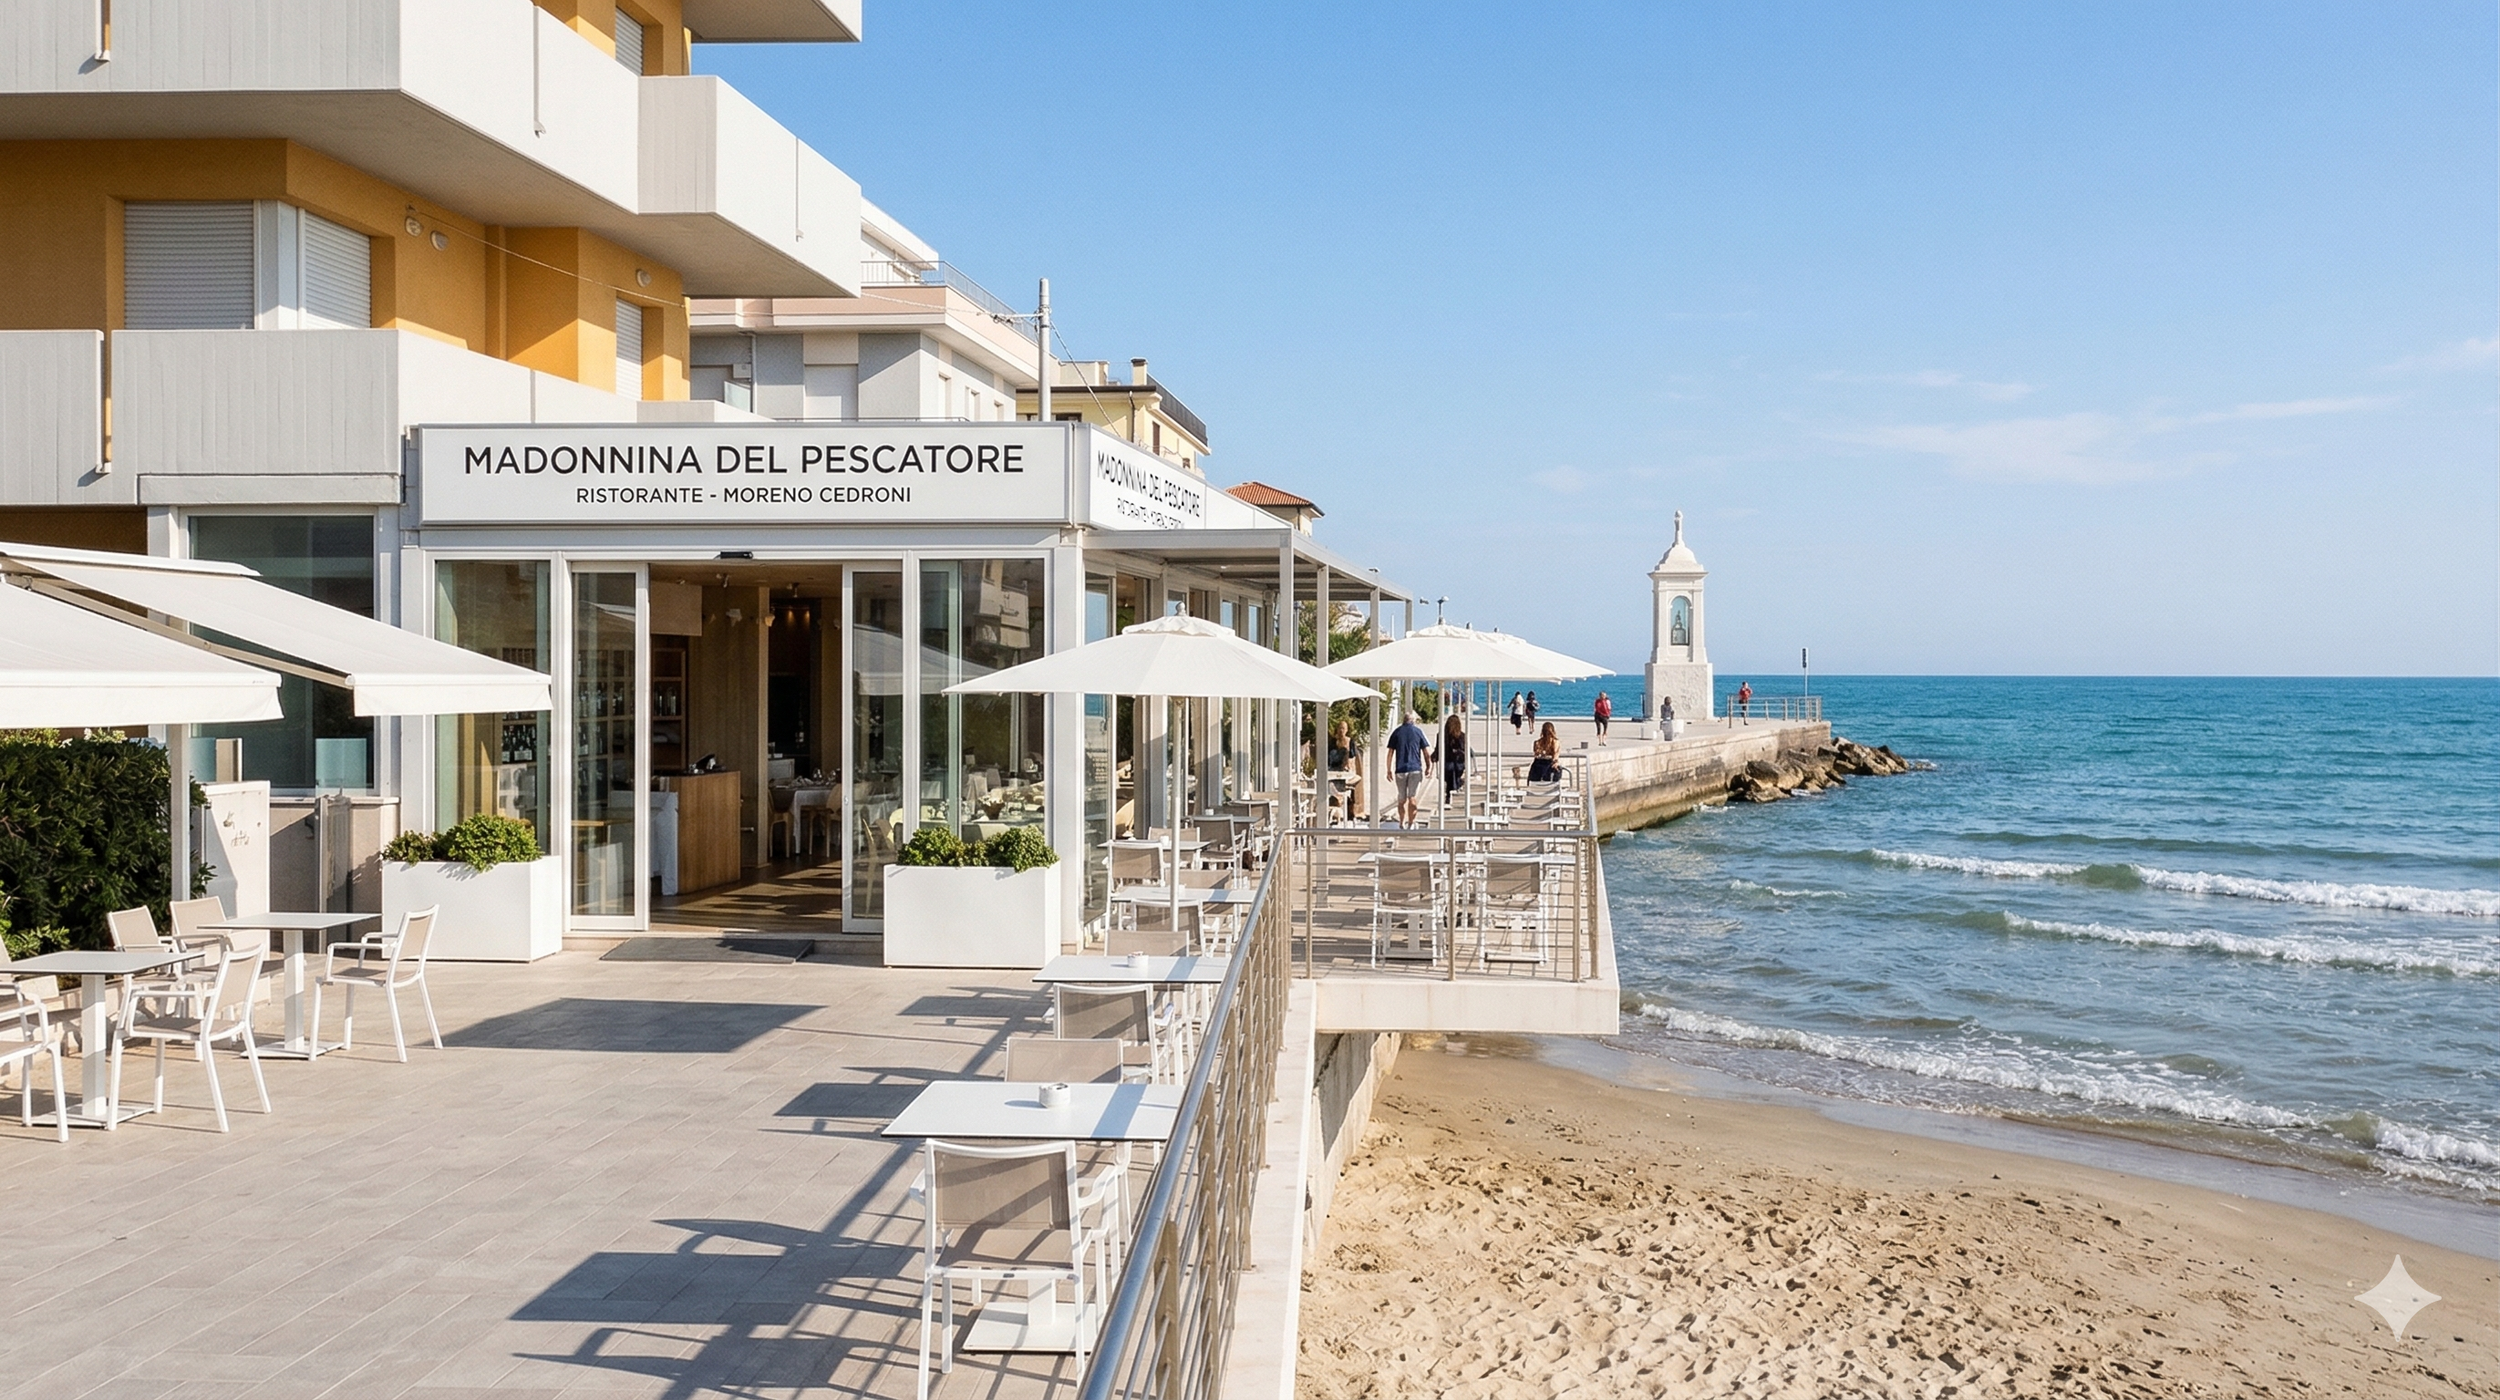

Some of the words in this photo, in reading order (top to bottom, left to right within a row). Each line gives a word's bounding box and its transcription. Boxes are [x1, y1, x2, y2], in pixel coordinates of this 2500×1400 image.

[464, 445, 703, 475] MADONNINA
[716, 445, 788, 474] DEL
[801, 444, 1024, 474] PESCATORE
[1097, 449, 1148, 495] MADONNINA
[576, 487, 703, 504] RISTORANTE
[723, 487, 813, 503] MORENO
[819, 486, 911, 503] CEDRONI
